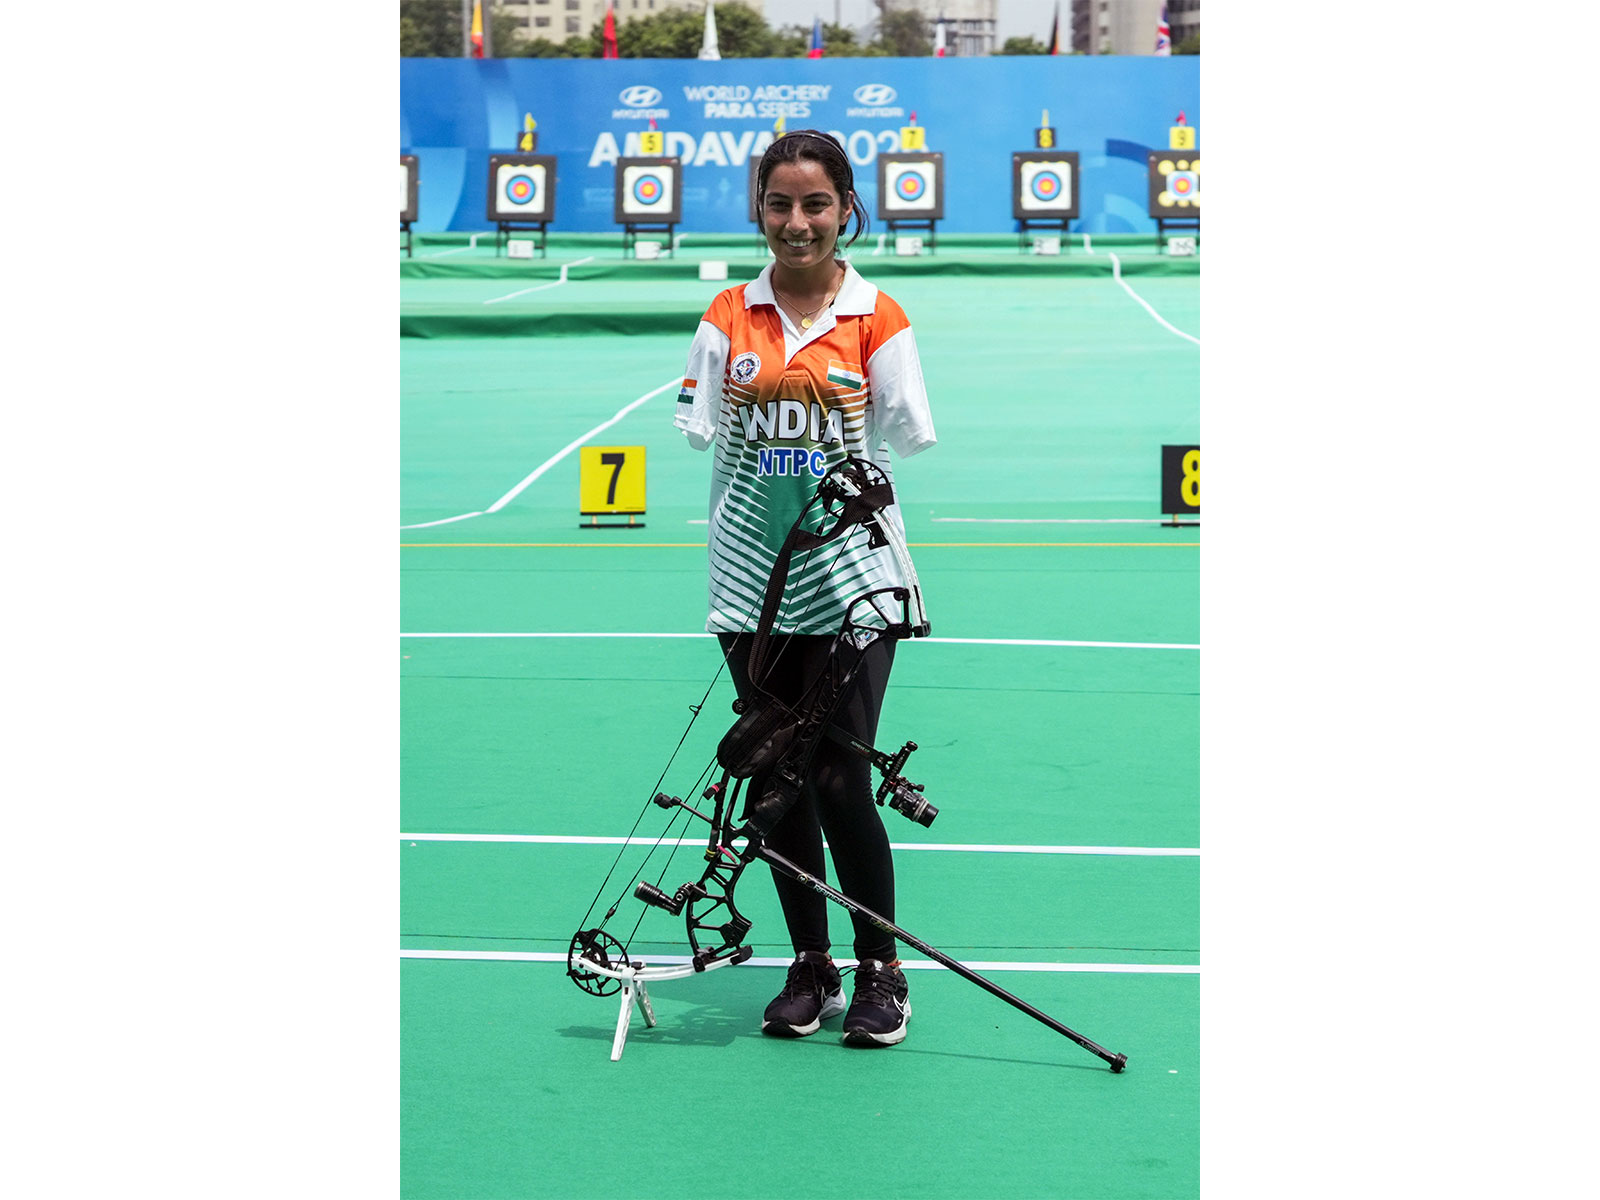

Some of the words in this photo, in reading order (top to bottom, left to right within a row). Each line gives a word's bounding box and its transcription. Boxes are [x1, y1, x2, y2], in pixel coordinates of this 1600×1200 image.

[683, 85, 750, 101] WORLD
[752, 84, 831, 101] ARCHERY
[704, 102, 756, 118] PARA
[757, 101, 811, 118] SERIES
[520, 132, 534, 151] 4
[647, 133, 656, 151] 5
[907, 129, 917, 147] 7
[1039, 128, 1053, 148] 8
[1176, 129, 1187, 147] 9
[737, 399, 846, 447] INDIA
[757, 447, 826, 477] NTPC
[601, 452, 625, 504] 7
[1181, 449, 1200, 507] 8
[813, 883, 858, 914] RAMRODS
